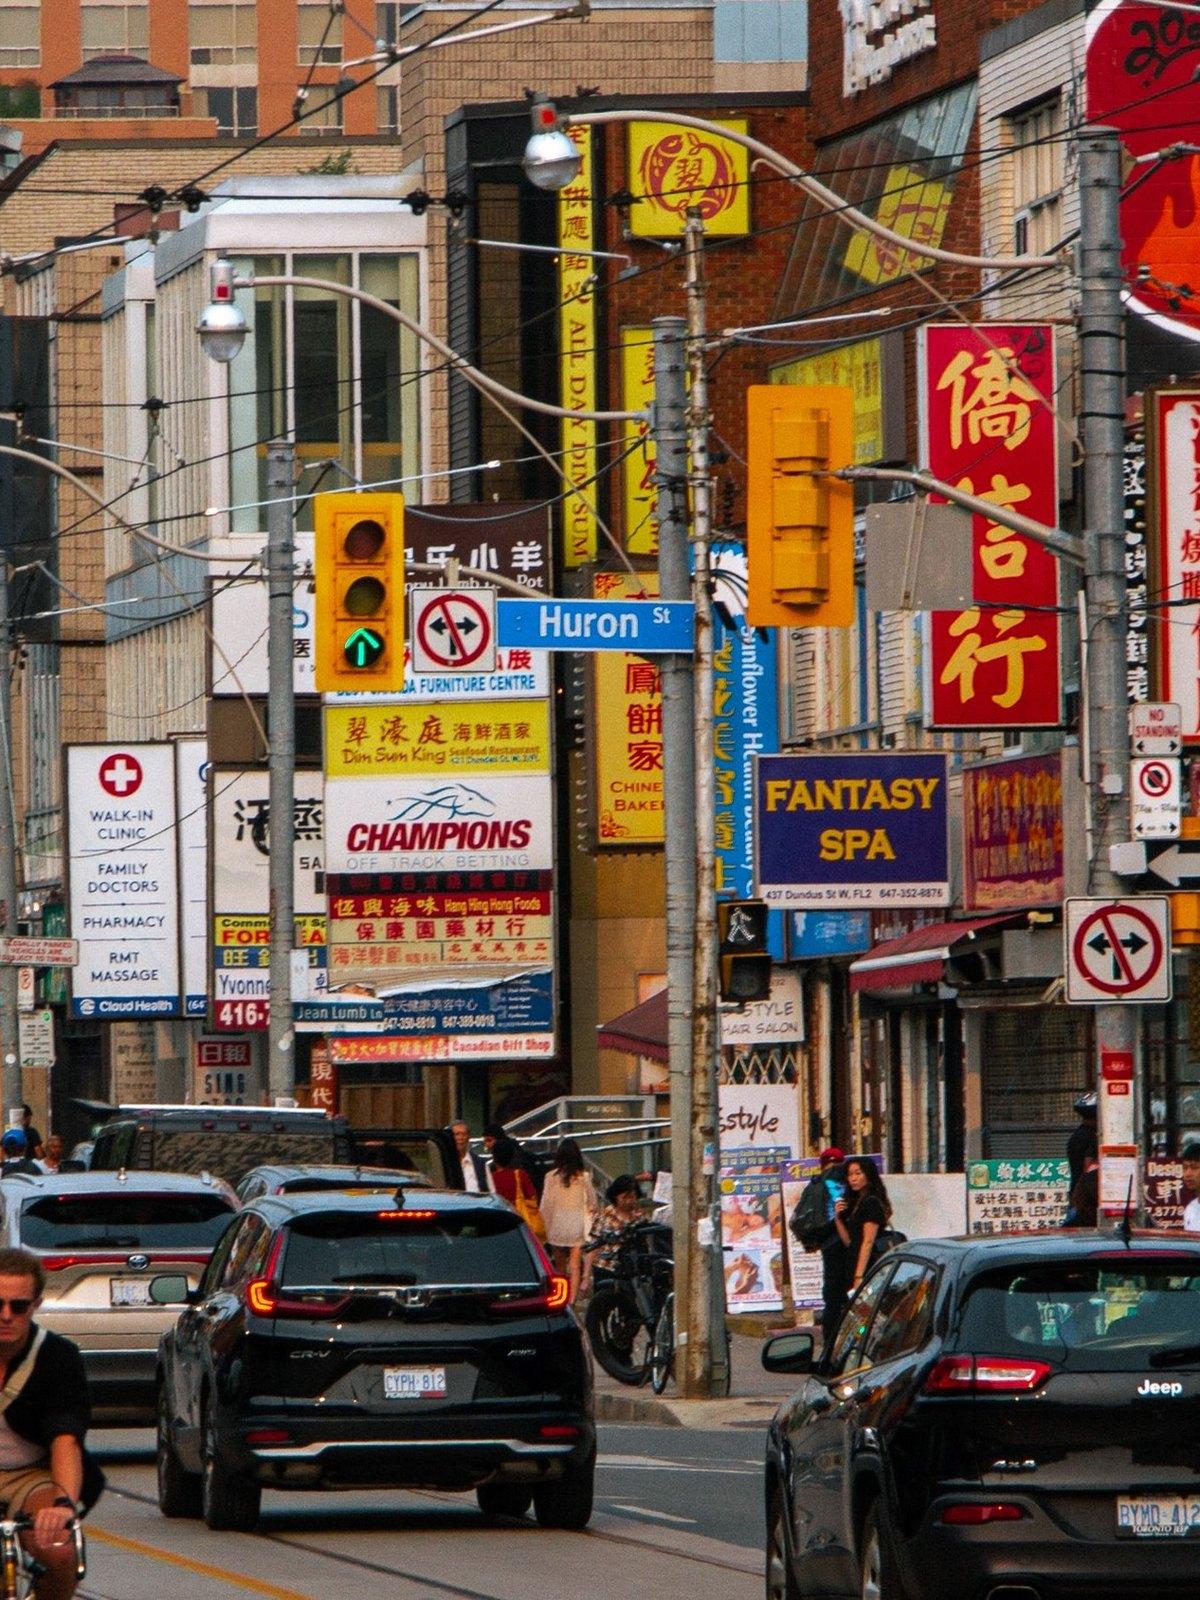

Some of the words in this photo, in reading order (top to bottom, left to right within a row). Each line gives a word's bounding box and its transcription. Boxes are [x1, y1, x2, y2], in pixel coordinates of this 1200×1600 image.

[570, 319, 587, 368] ALL
[570, 375, 587, 431] DAY
[572, 442, 588, 494] DIM
[573, 502, 589, 557] SUM
[517, 574, 544, 588] Pot
[539, 604, 639, 639] Huron
[652, 606, 671, 624] St
[420, 675, 485, 694] FURNITURE
[489, 674, 536, 691] CENTRE
[1149, 708, 1165, 722] NO
[1134, 724, 1180, 739] STANDING
[342, 747, 372, 765] Dim
[375, 746, 409, 764] Sum
[411, 746, 446, 765] King
[765, 778, 940, 813] FANTASY
[90, 809, 154, 823] WALK-IN
[97, 827, 147, 840] CLINIC
[346, 819, 533, 853] CHAMPIONS
[819, 828, 897, 862] SPA
[98, 863, 148, 876] FAMILY
[346, 857, 378, 871] OFF
[390, 855, 445, 870] TRACK
[456, 853, 530, 869] BETTING
[87, 880, 159, 894] DOCTORS
[514, 896, 541, 911] Foods
[83, 916, 166, 930] PHARMACY
[222, 930, 270, 944] FOR
[109, 952, 140, 965] RMT
[91, 969, 160, 983] MASSAGE
[99, 1000, 135, 1012] Cloud
[134, 1000, 173, 1012] Health
[331, 1005, 367, 1020] Lumb
[370, 1010, 383, 1019] Ln
[720, 1023, 751, 1036] HAIR
[756, 1021, 799, 1034] SALON
[452, 1039, 501, 1052] Canadian
[502, 1038, 523, 1052] Gift
[525, 1038, 551, 1053] Shop
[204, 1073, 246, 1095] SING
[1147, 1162, 1185, 1178] Desig
[1137, 1379, 1183, 1397] Jeep
